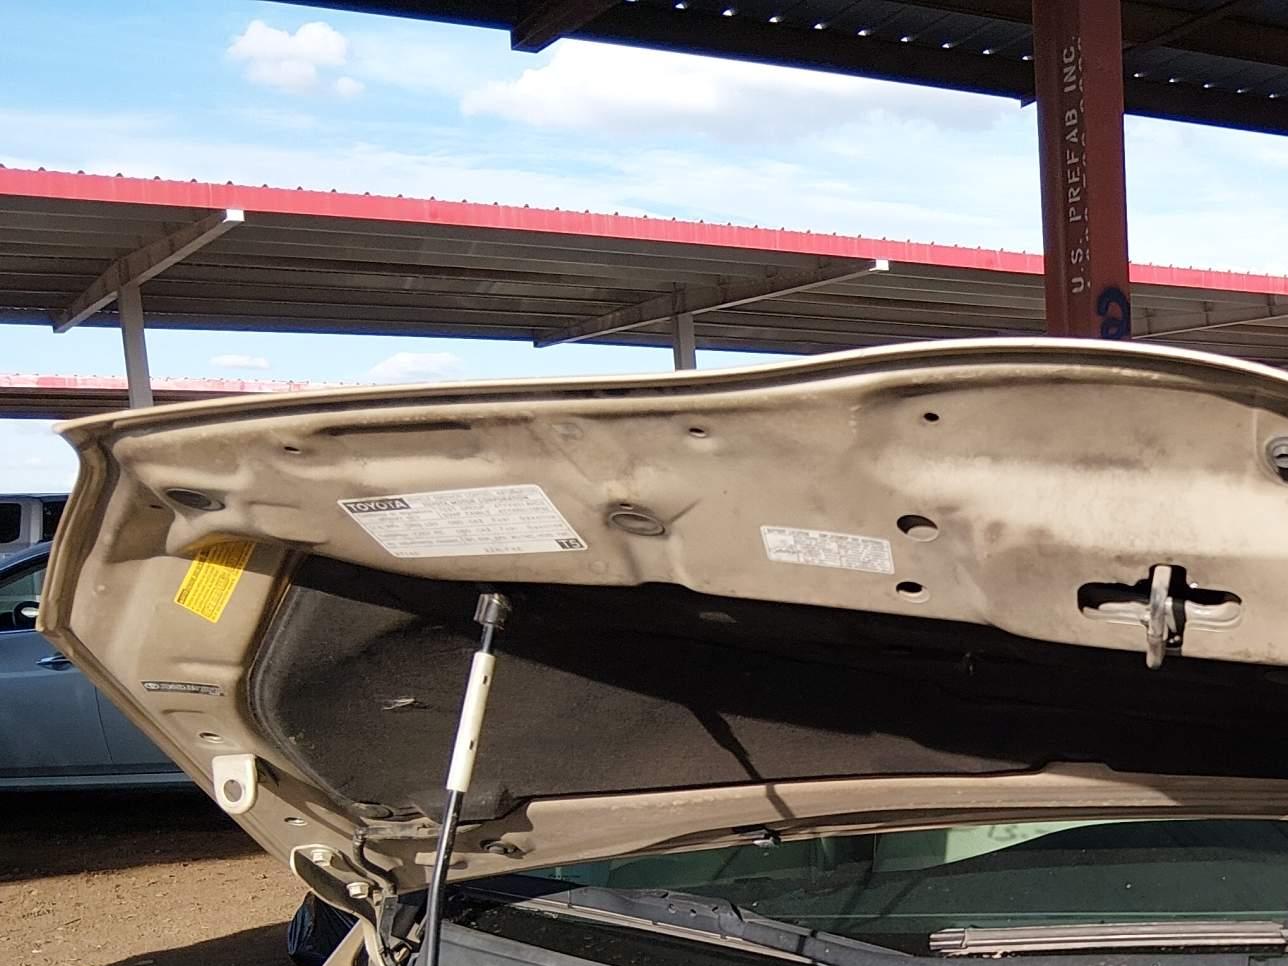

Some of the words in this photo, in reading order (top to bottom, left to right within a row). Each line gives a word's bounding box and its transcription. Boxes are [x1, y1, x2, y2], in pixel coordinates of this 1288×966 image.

[1062, 36, 1078, 93] INC.
[1065, 109, 1083, 222] PREFAB
[1070, 239, 1086, 293] U.S.
[346, 499, 409, 512] TOYOTA
